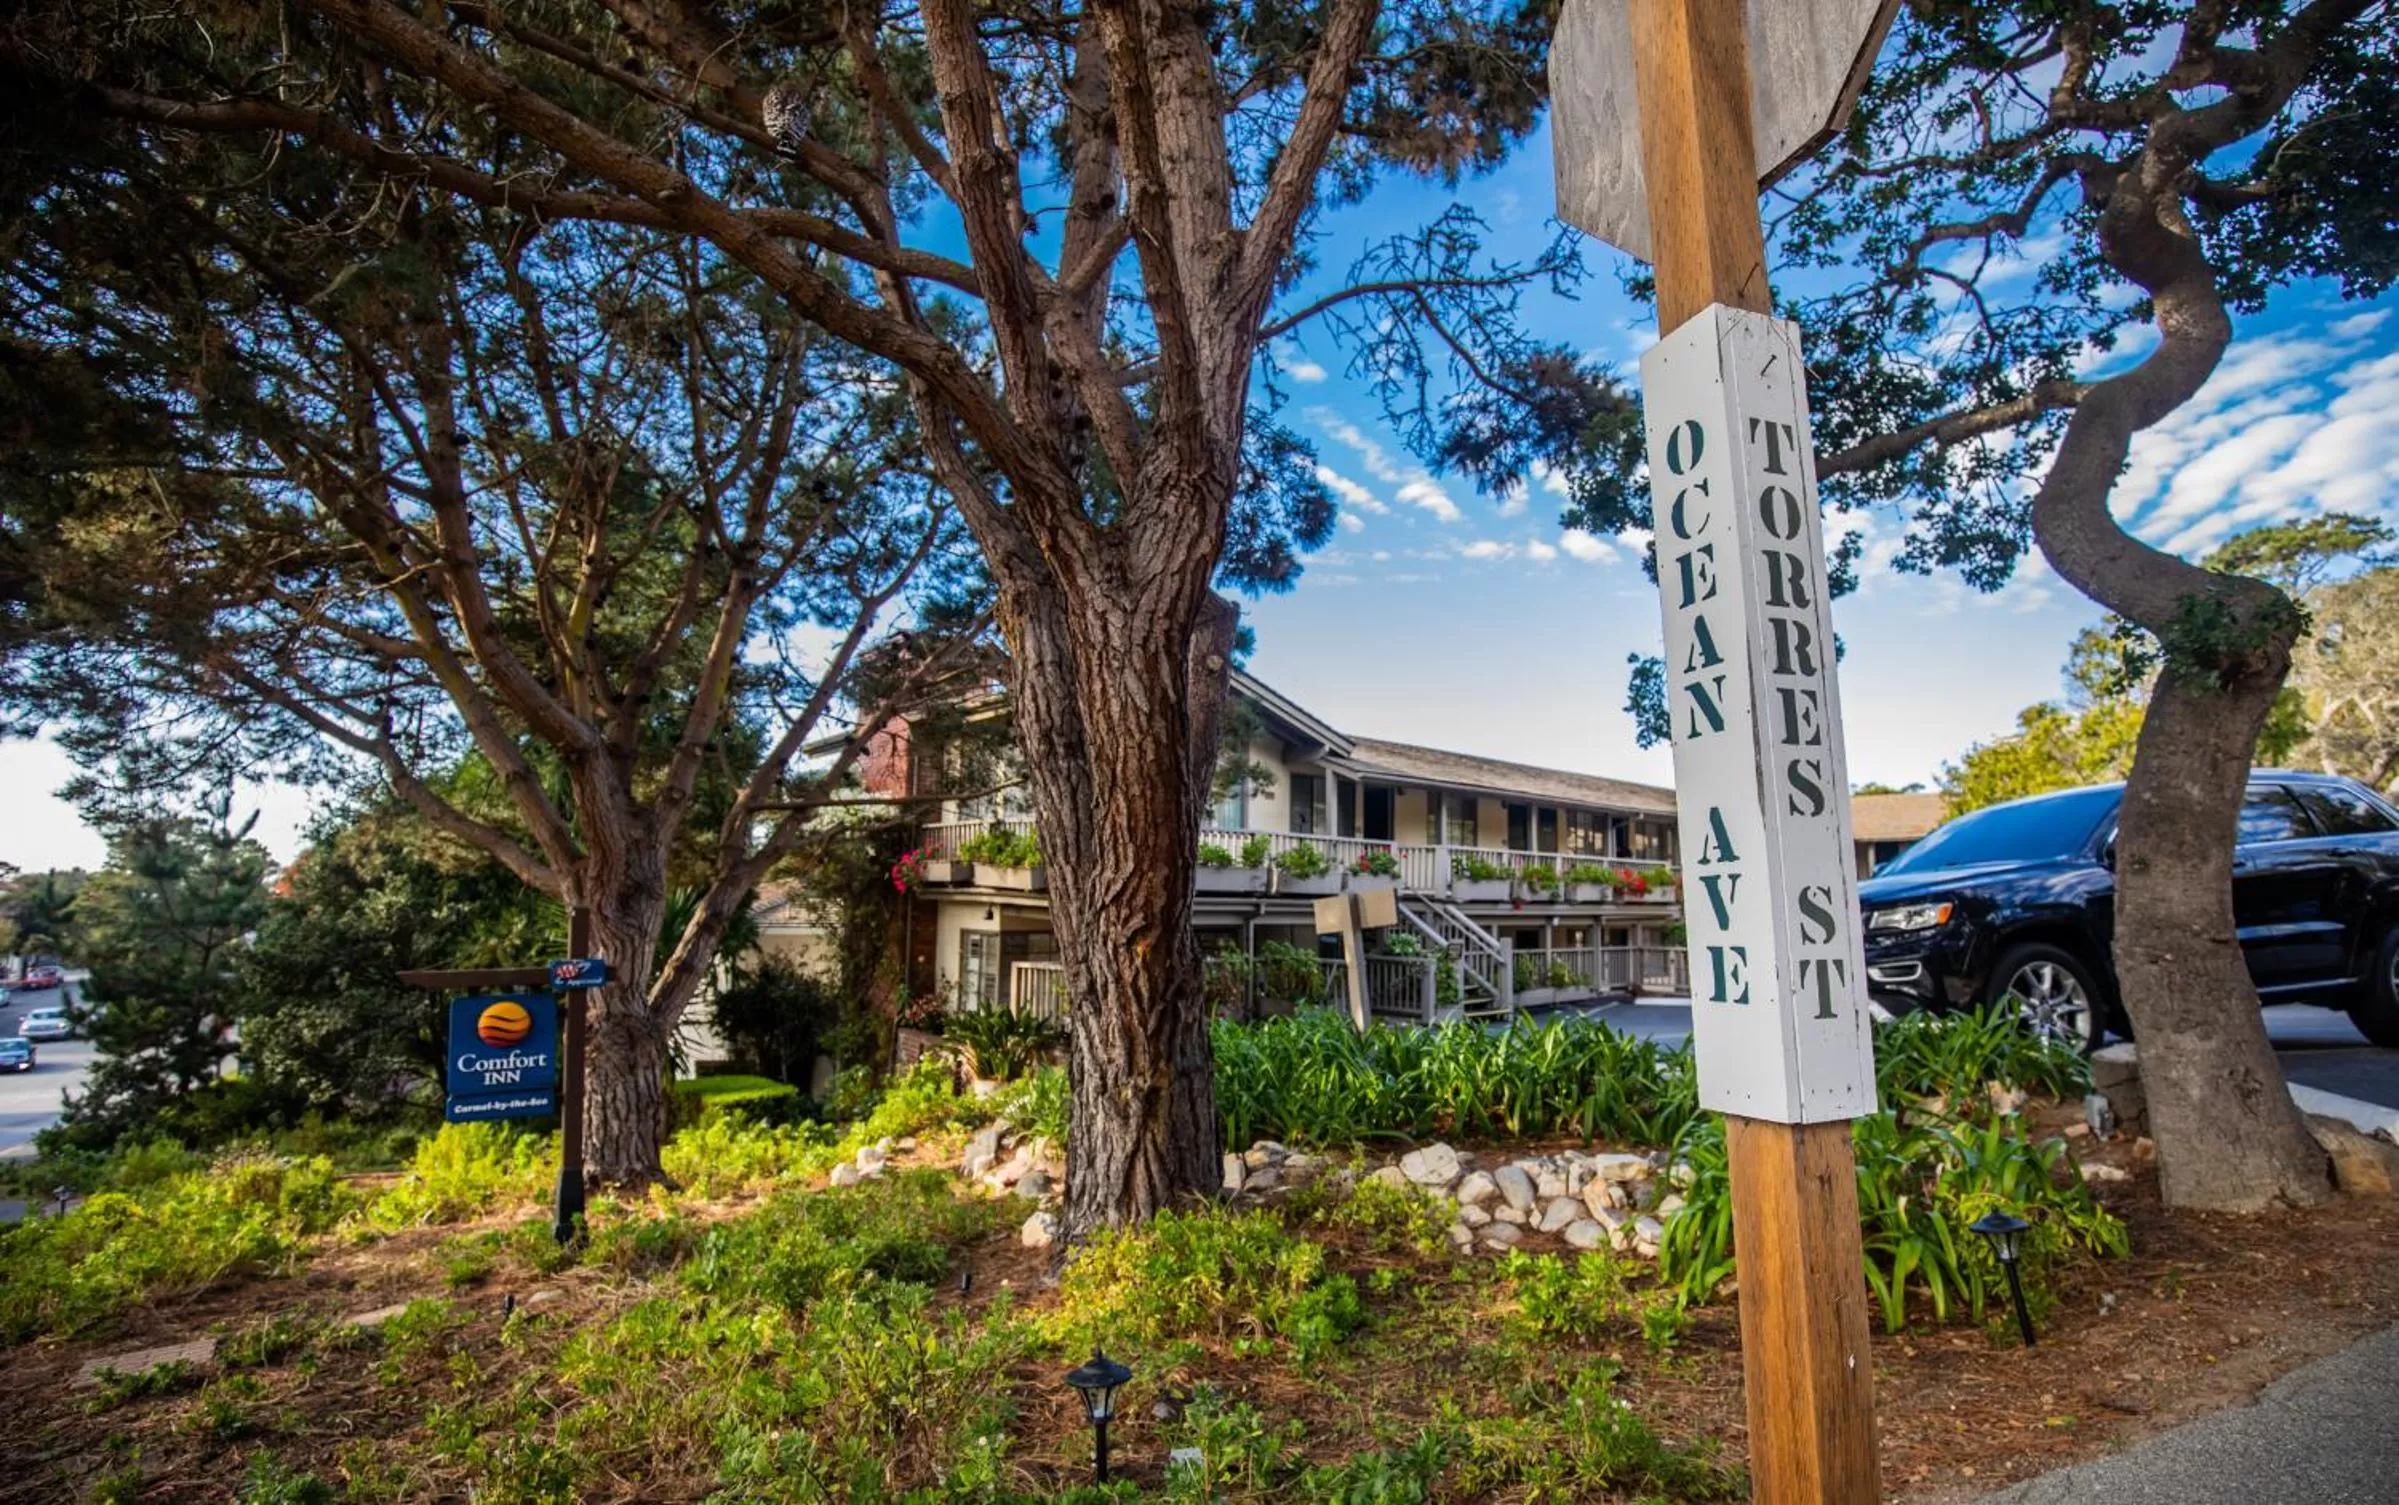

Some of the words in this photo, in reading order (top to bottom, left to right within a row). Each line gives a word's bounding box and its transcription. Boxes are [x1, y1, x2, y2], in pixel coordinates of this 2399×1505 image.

[1667, 420, 1725, 739] OCEAN
[1697, 806, 1750, 1005] AVE
[1749, 417, 1825, 818] TORRES
[1799, 885, 1846, 1020] ST
[457, 1050, 547, 1072] Comfort
[483, 1070, 521, 1085] INN
